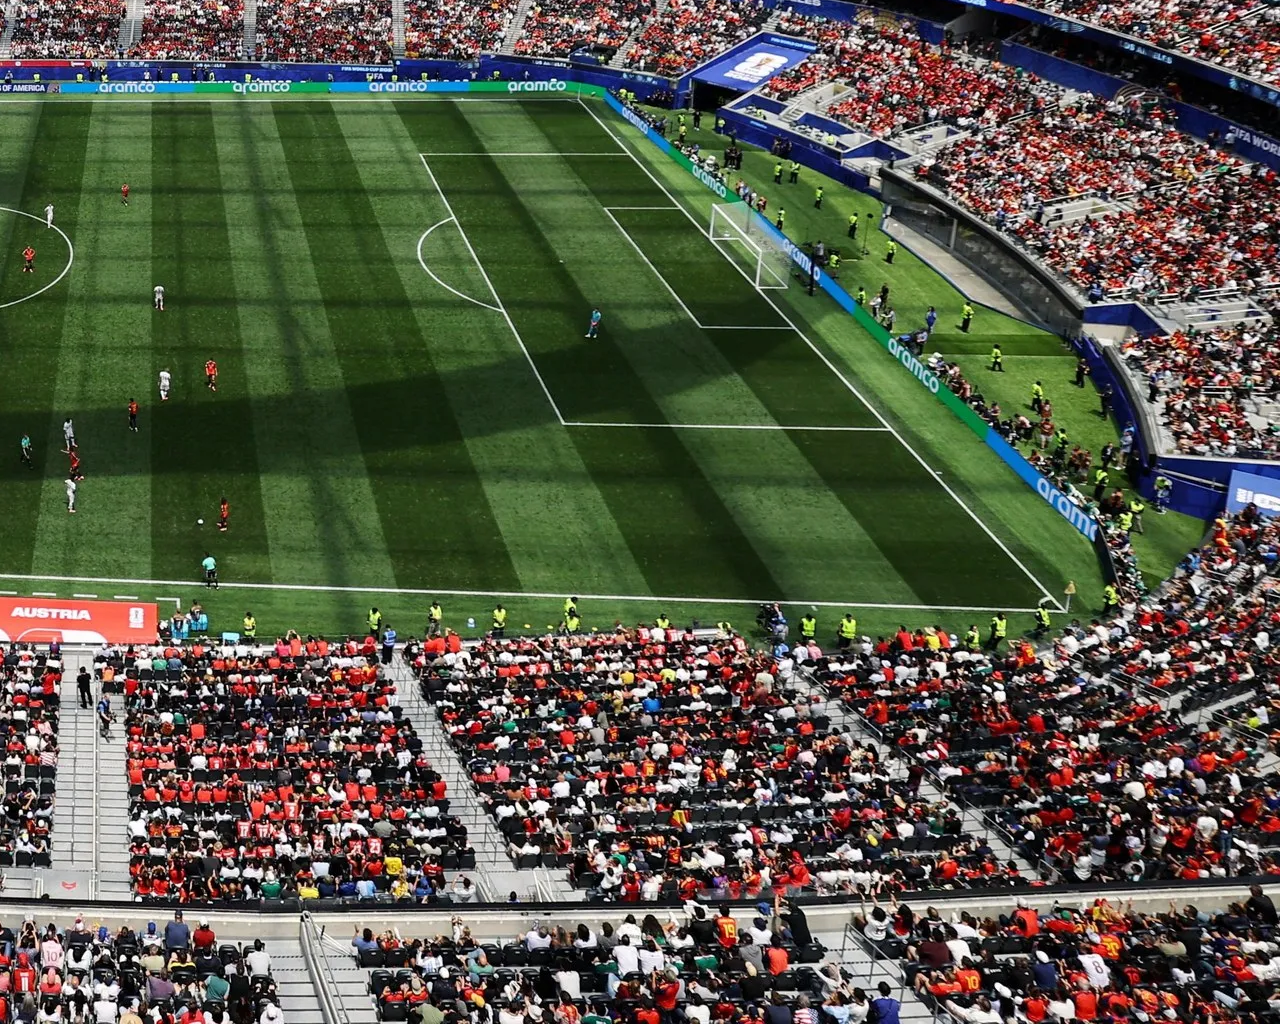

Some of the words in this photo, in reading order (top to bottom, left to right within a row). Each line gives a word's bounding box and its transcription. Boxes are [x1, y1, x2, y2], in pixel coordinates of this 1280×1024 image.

[99, 83, 155, 93] aramco
[233, 82, 290, 92] aramco
[369, 81, 428, 91] aramco
[508, 81, 566, 92] aramco
[621, 106, 649, 136] aramco
[1252, 135, 1280, 157] WOR
[692, 163, 727, 199] aramco
[888, 338, 939, 393] aramco
[1037, 477, 1098, 542] aramc
[11, 606, 91, 620] AUSTRIA
[289, 807, 295, 817] 2
[370, 841, 380, 852] 23
[723, 924, 735, 938] 19
[46, 950, 57, 961] 10
[1092, 960, 1103, 974] 8
[965, 975, 979, 990] 10
